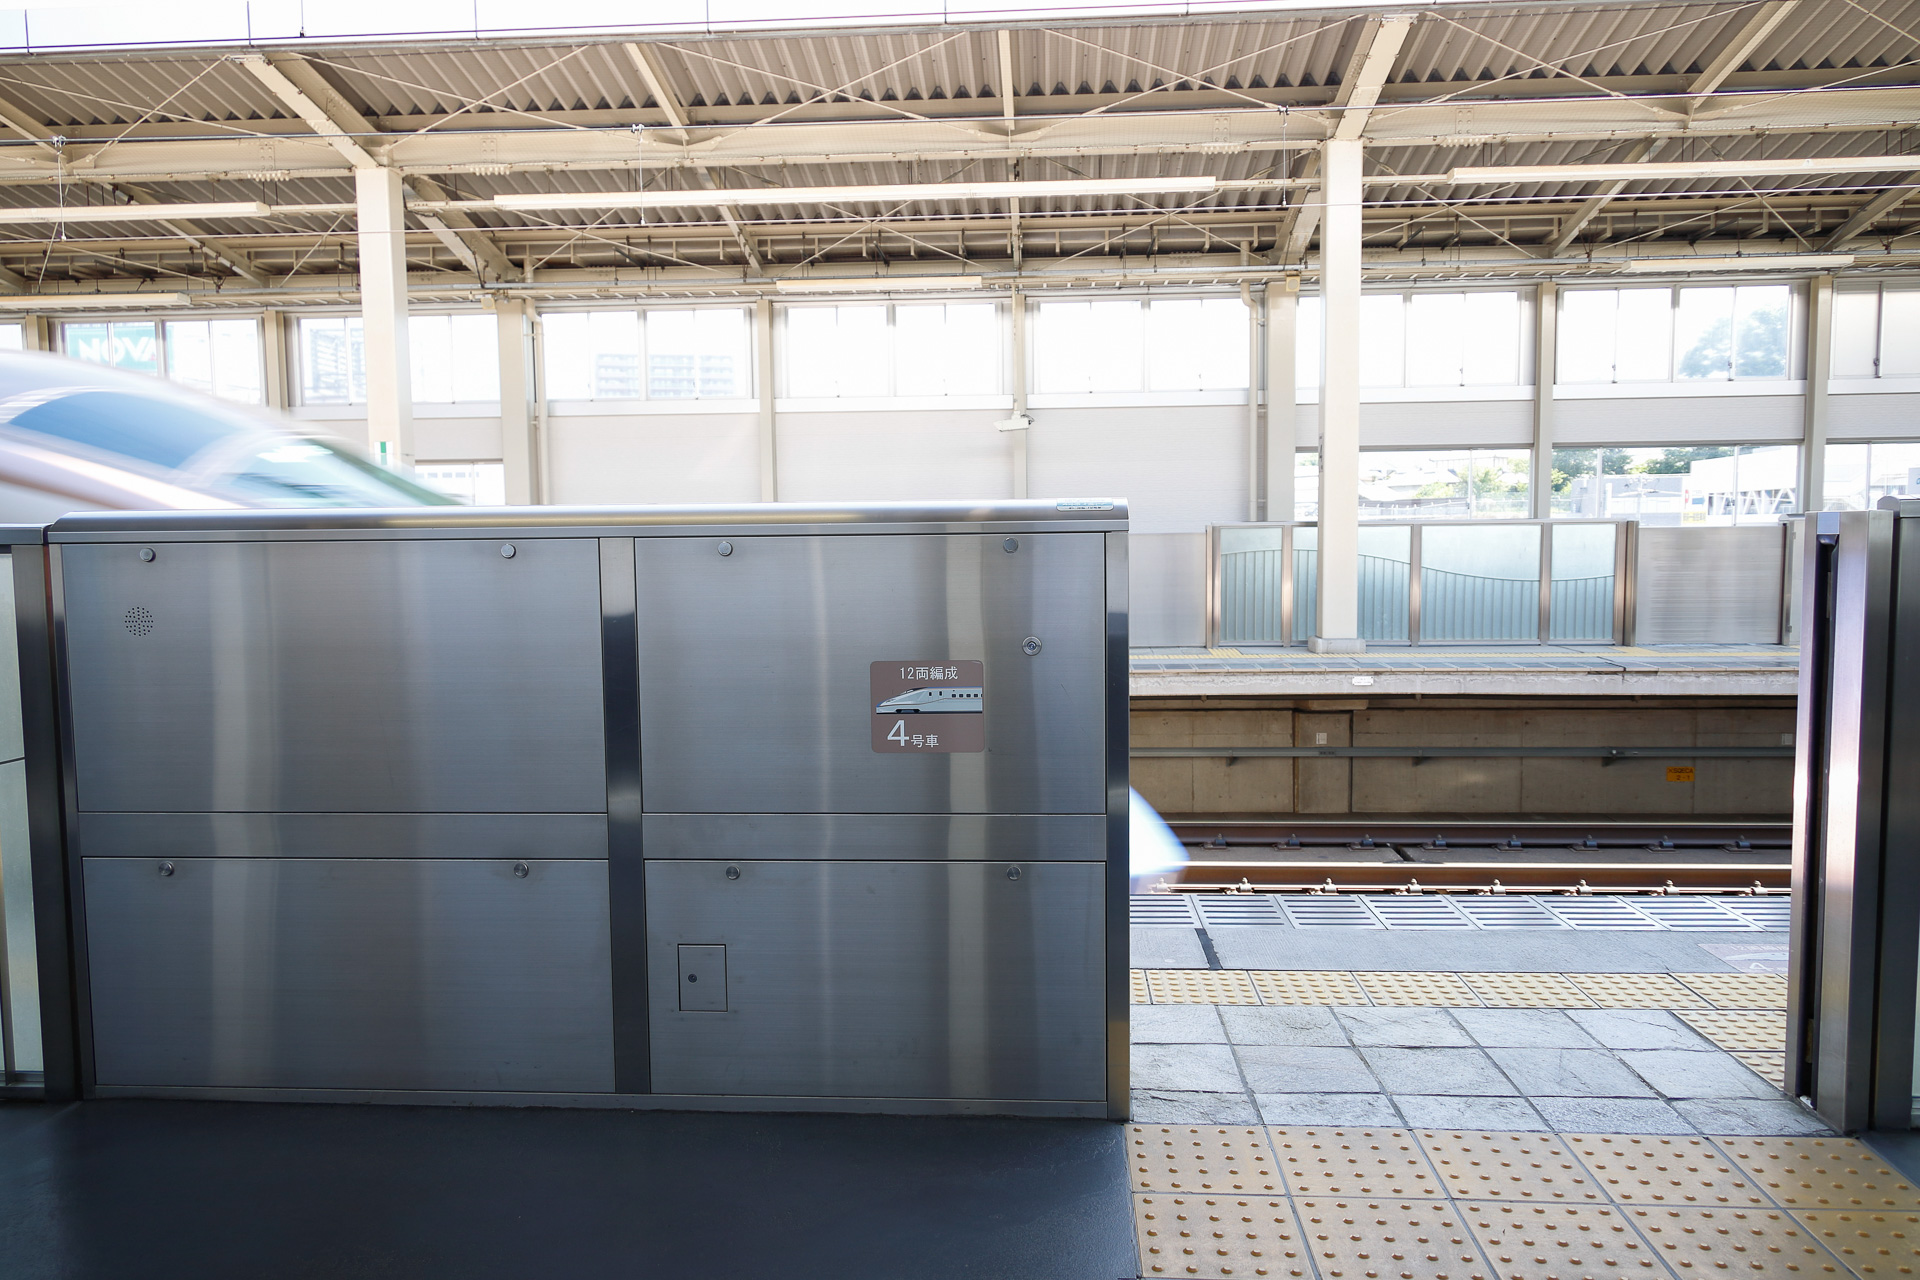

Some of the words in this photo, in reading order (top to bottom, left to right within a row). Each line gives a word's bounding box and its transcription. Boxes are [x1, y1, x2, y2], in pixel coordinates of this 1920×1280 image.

[77, 336, 157, 363] NOVA
[899, 666, 959, 680] 12両編成
[887, 719, 940, 748] 4号車
